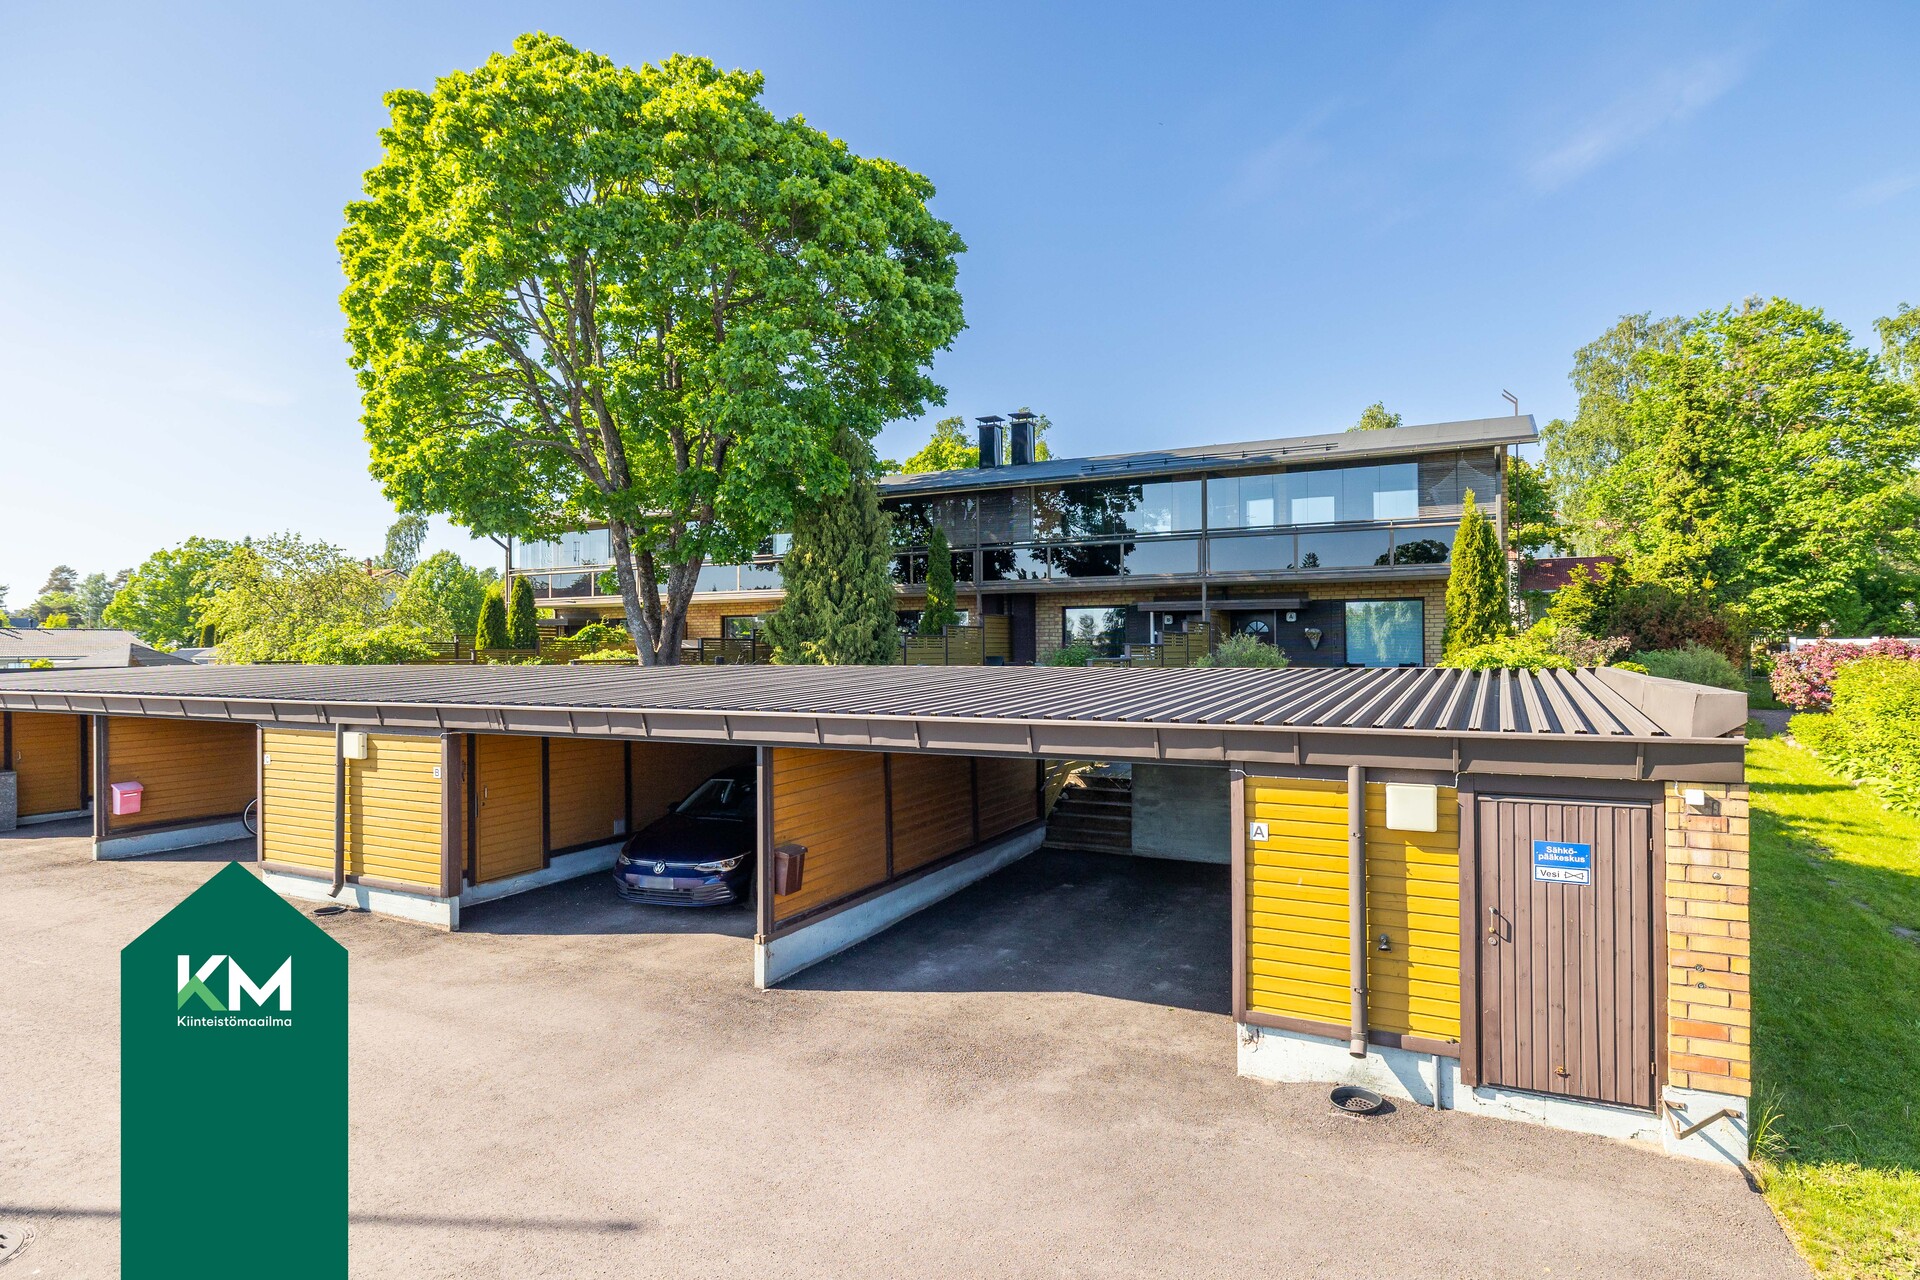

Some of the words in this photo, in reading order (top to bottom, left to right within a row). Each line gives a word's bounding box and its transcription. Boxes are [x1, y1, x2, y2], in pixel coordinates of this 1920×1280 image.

[1253, 825, 1265, 838] A
[1546, 845, 1578, 855] Sähkö-
[1538, 853, 1586, 863] pääkeskus
[1540, 869, 1560, 878] Vesi
